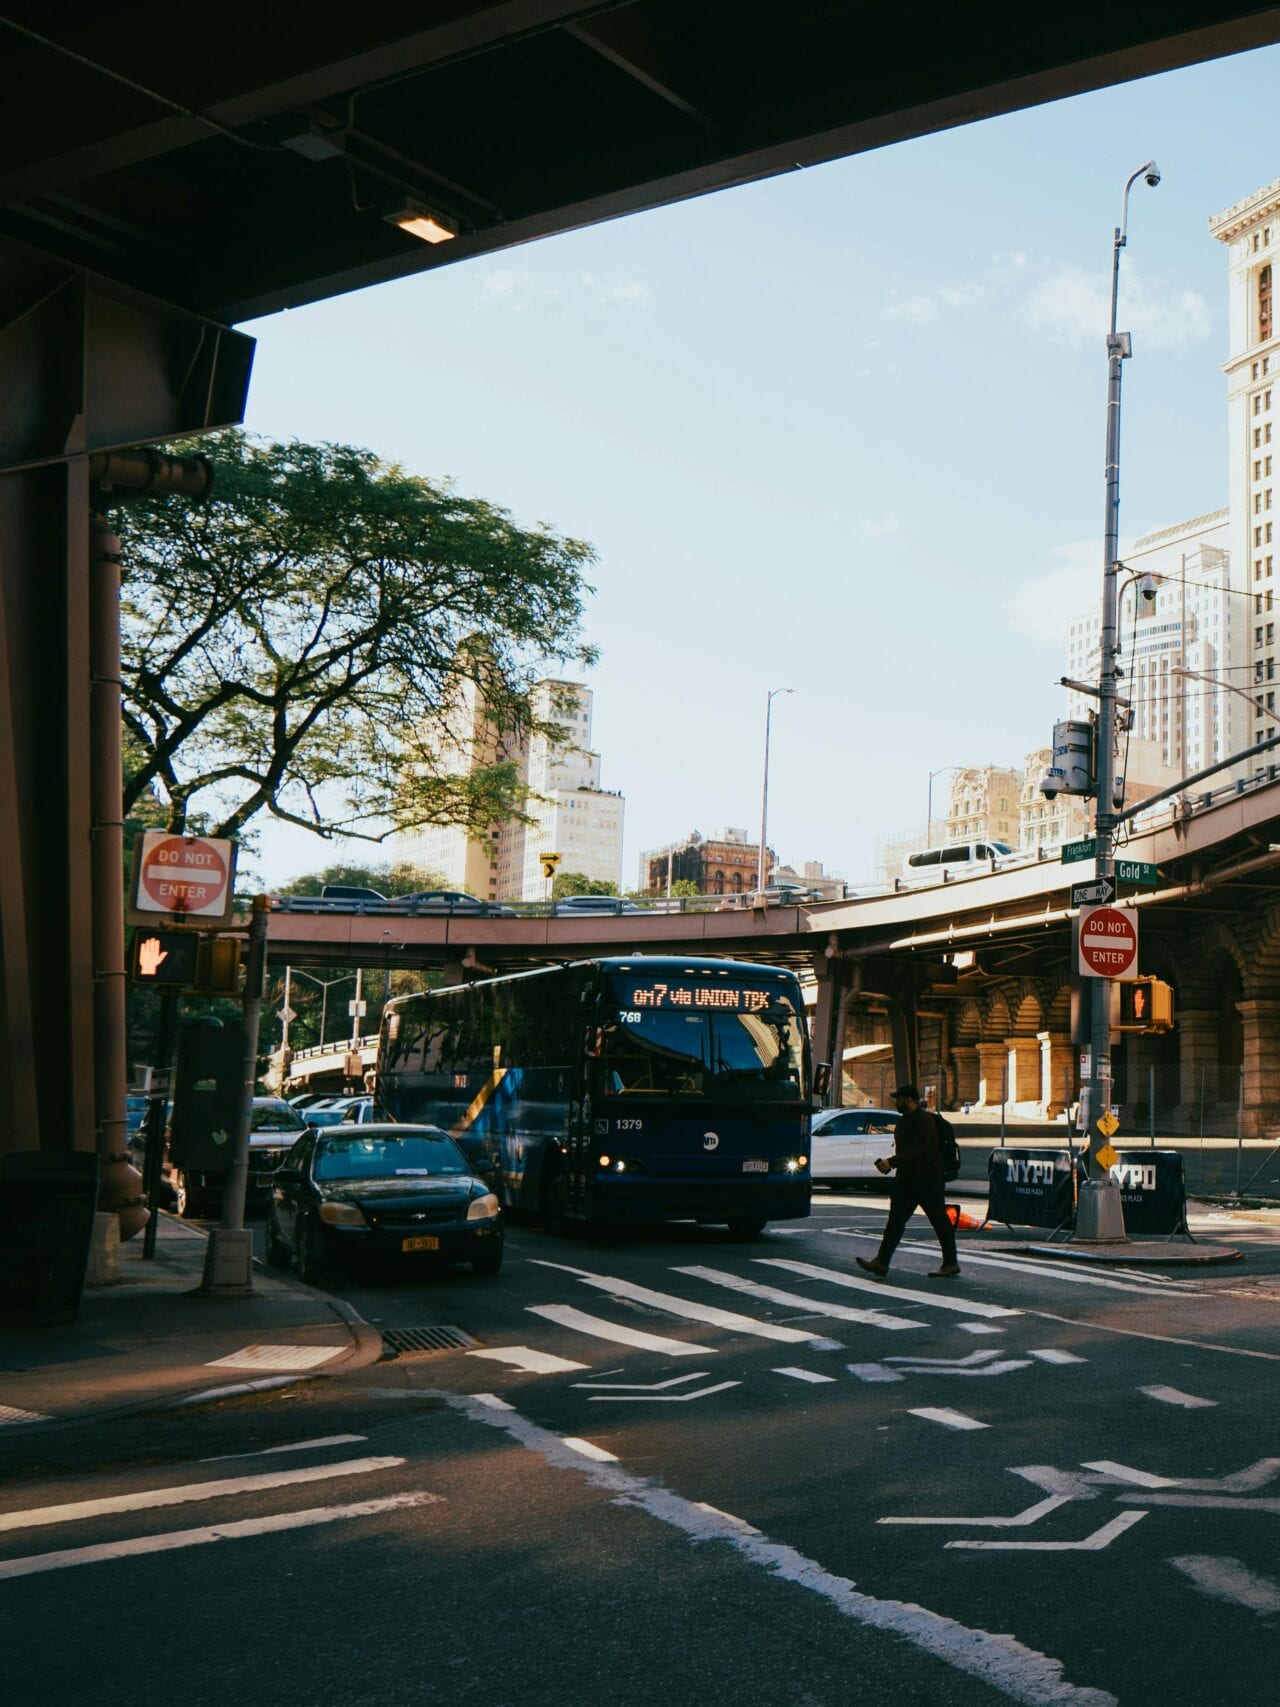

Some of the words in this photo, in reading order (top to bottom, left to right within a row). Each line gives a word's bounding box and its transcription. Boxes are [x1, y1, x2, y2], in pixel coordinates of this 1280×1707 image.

[1067, 842, 1092, 856] Frankfort
[159, 850, 179, 863] DO
[185, 852, 213, 865] NOT
[1120, 862, 1140, 879] Gold
[159, 884, 206, 899] ENTER
[1075, 889, 1088, 901] ONE
[1095, 885, 1108, 897] WAY
[1090, 921, 1104, 931] DO
[1107, 922, 1127, 934] NOT
[1092, 951, 1124, 964] ENTER
[670, 988, 692, 1005] via
[695, 989, 739, 1007] UNION
[742, 991, 770, 1008] TPK
[616, 1119, 643, 1130] 1379
[1006, 1159, 1055, 1184] NYPD
